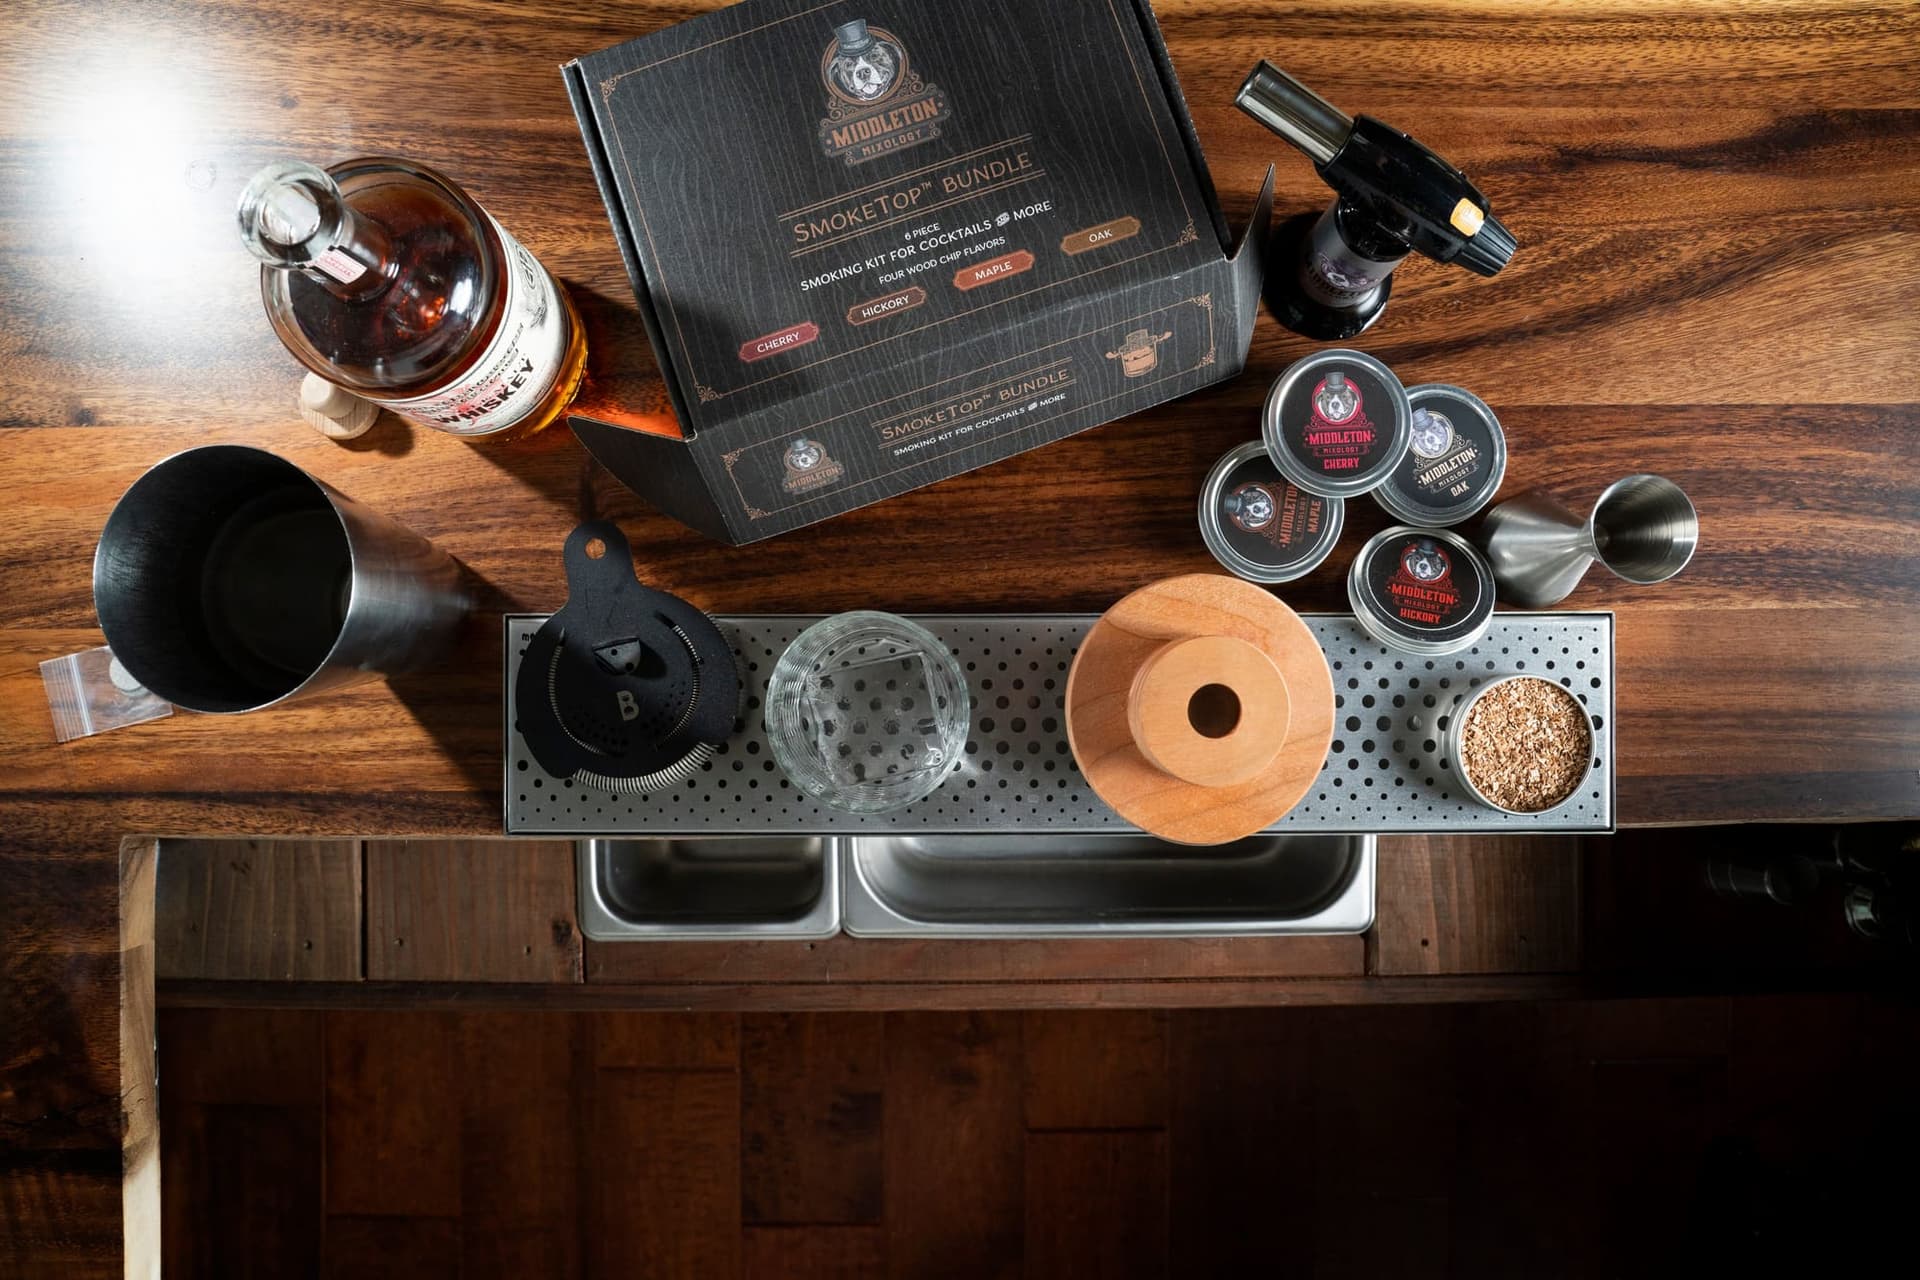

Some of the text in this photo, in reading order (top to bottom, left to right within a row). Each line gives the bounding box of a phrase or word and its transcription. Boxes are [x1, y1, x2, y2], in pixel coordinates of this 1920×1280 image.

[831, 97, 938, 148] MIDDLETON
[862, 129, 921, 156] MIXOLOGY
[942, 152, 1033, 193] BUNDLE
[904, 223, 941, 241] 6 PIECE
[1088, 228, 1113, 243] OAK
[800, 262, 863, 291] SMOKING
[865, 252, 887, 270] KIT
[889, 245, 916, 263] FOR
[919, 219, 992, 251] COCKTAILS
[1013, 200, 1052, 221] MORE
[878, 236, 1006, 285] FOUR WOOD CHIP FLAVORS
[974, 260, 1013, 281] MAPLE
[861, 295, 910, 319] HICKORY
[756, 331, 801, 353] CHERRY
[434, 356, 535, 425] WHISKEY
[999, 369, 1070, 401] BUNDLE
[893, 436, 937, 456] SMOKING
[938, 431, 953, 441] KIT
[955, 425, 973, 435] FOR
[975, 407, 1025, 429] COCKTAILS
[1039, 393, 1066, 407] MORE
[1308, 430, 1372, 445] MIDDLETON
[1323, 457, 1360, 470] CHERRY
[1420, 447, 1476, 486] MIDDLETON
[1438, 467, 1470, 487] MIXOLOGY
[1450, 480, 1470, 497] OAK
[1307, 500, 1321, 534] MAPLE
[1391, 583, 1454, 605] MIDDLETON
[1400, 607, 1441, 625] HICKORY
[616, 690, 640, 721] B
